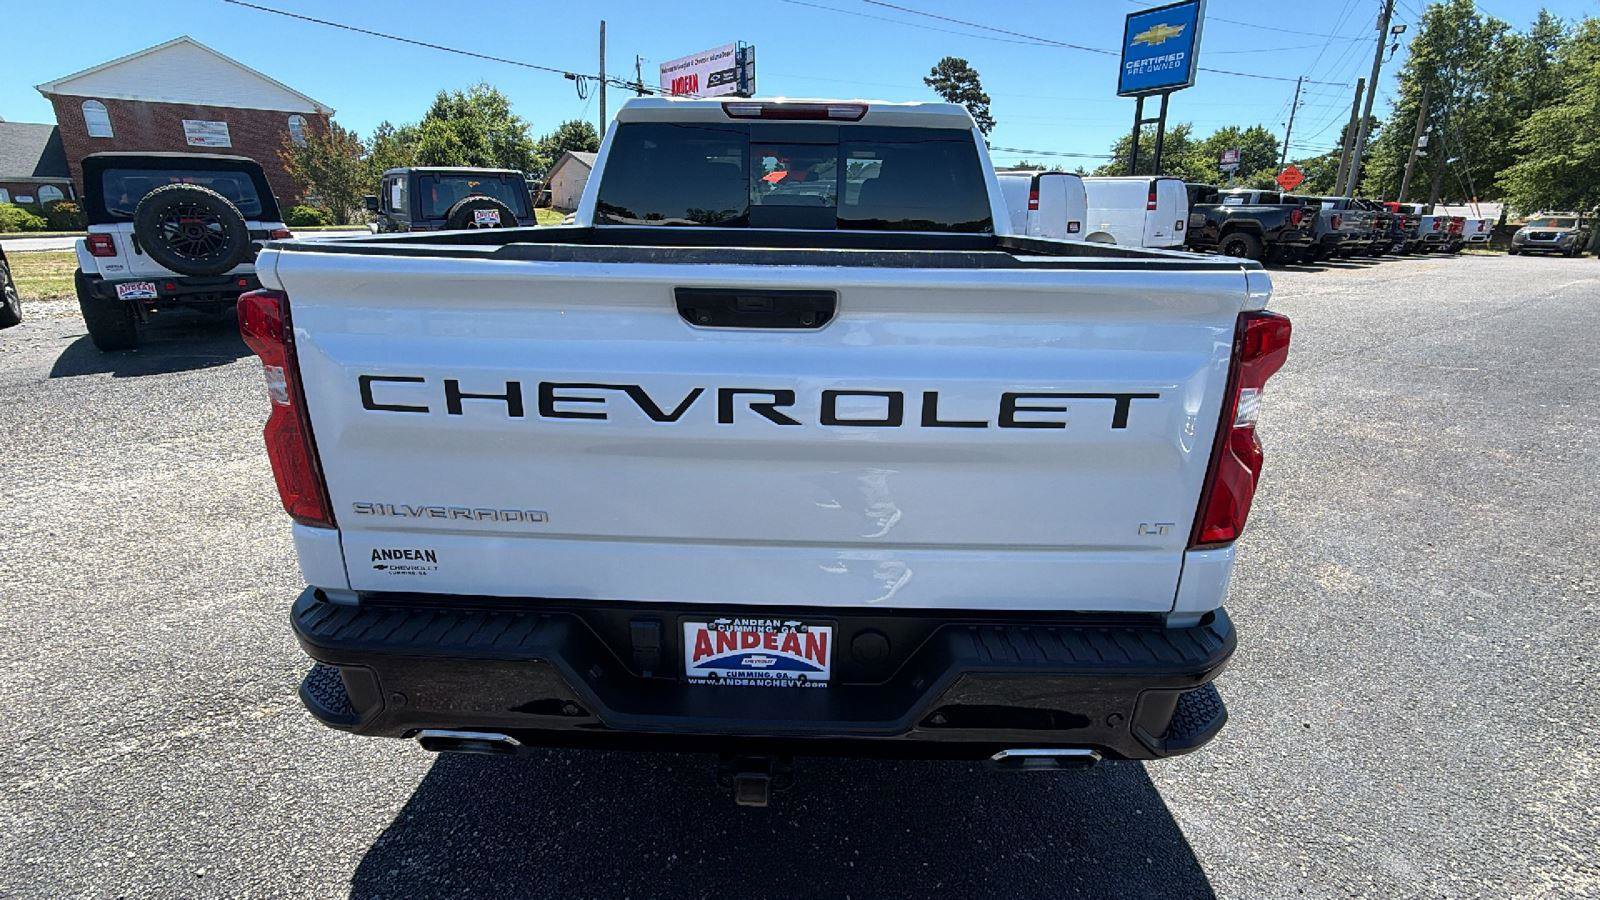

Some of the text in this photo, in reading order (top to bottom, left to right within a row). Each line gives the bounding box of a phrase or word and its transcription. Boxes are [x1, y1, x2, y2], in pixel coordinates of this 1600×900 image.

[1126, 52, 1185, 69] CERTIFIED
[1127, 60, 1181, 75] PRE OWNED
[672, 74, 698, 95] ANDEAN
[120, 285, 154, 294] ANDEAN
[358, 375, 1160, 429] CHEVROLET
[352, 502, 549, 523] SILVERADO
[1138, 522, 1176, 536] LT
[372, 548, 438, 563] ANDEAN
[733, 618, 781, 627] ANDEAN
[781, 626, 797, 634] GA
[693, 629, 827, 667] ANDEAN
[688, 677, 828, 688] www.ANDEANCHEVY.com
[726, 671, 774, 680] CUMMING,
